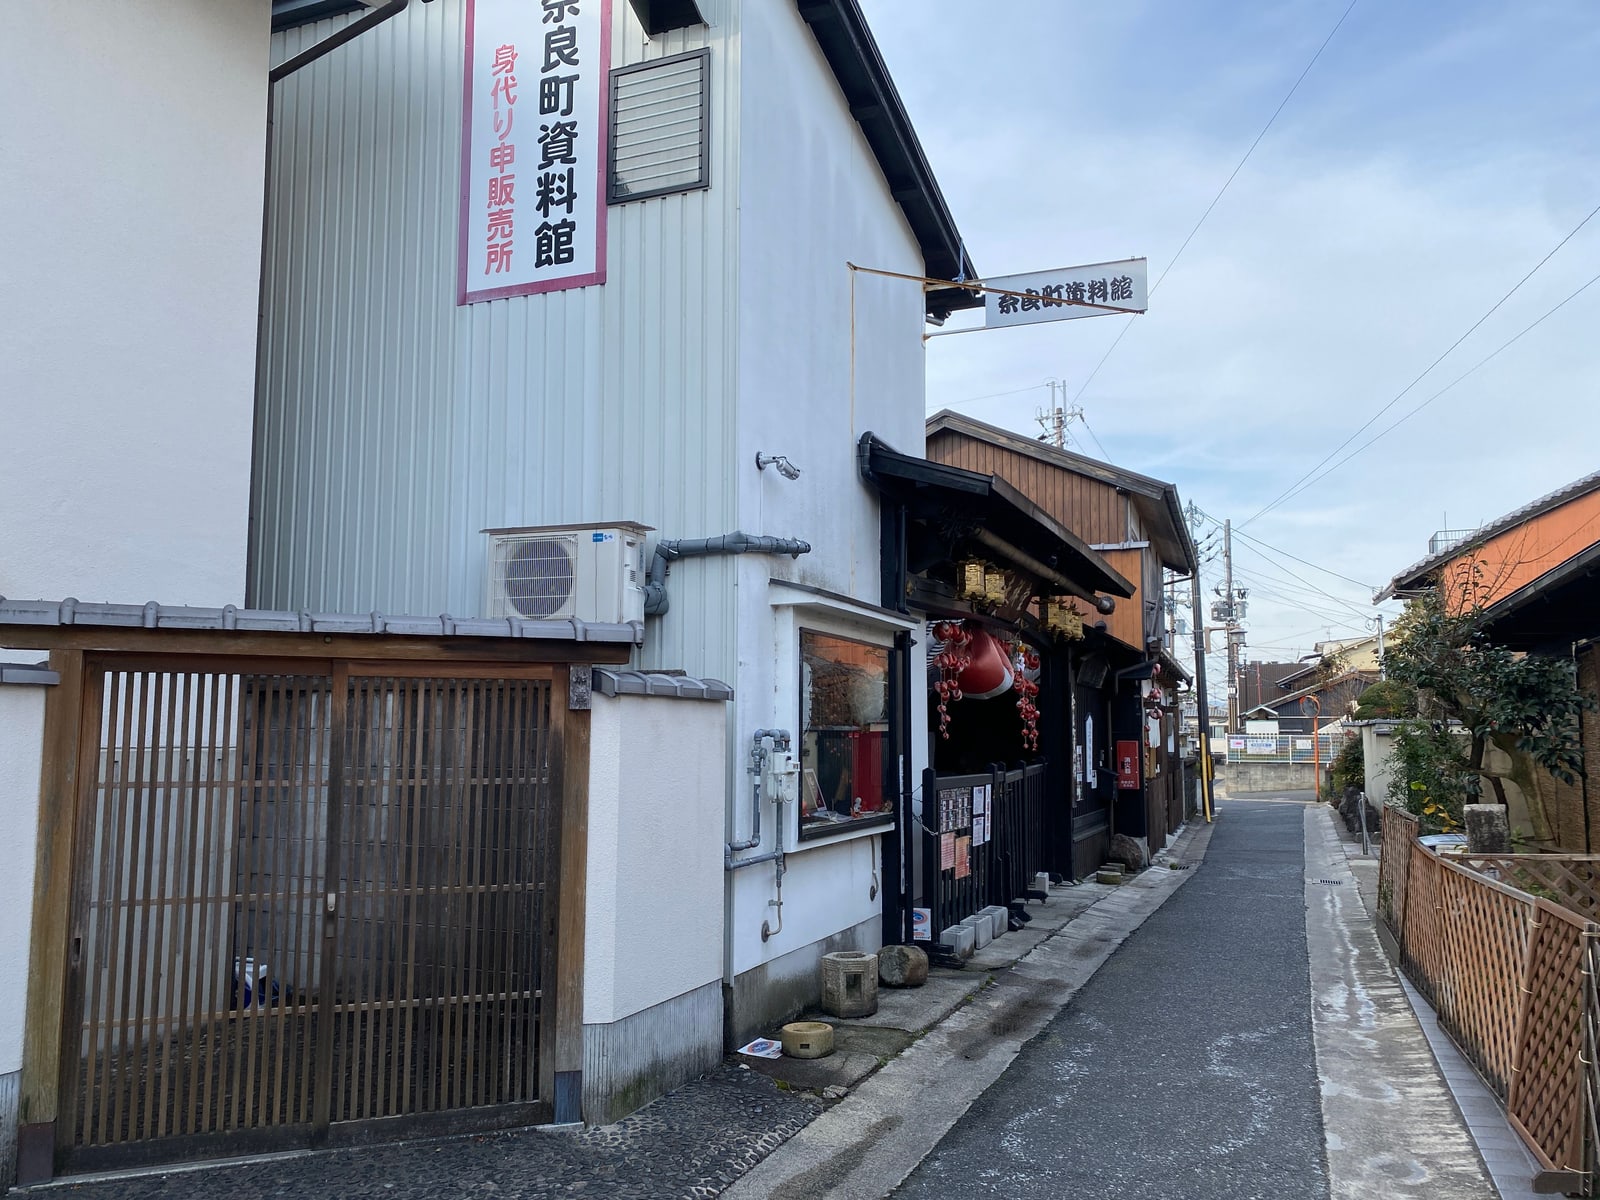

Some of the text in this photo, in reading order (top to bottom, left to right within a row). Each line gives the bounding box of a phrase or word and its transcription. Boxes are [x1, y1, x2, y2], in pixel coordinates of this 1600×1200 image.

[484, 44, 519, 275] 身代り申販売所
[998, 275, 1133, 314] 奈良町資料館
